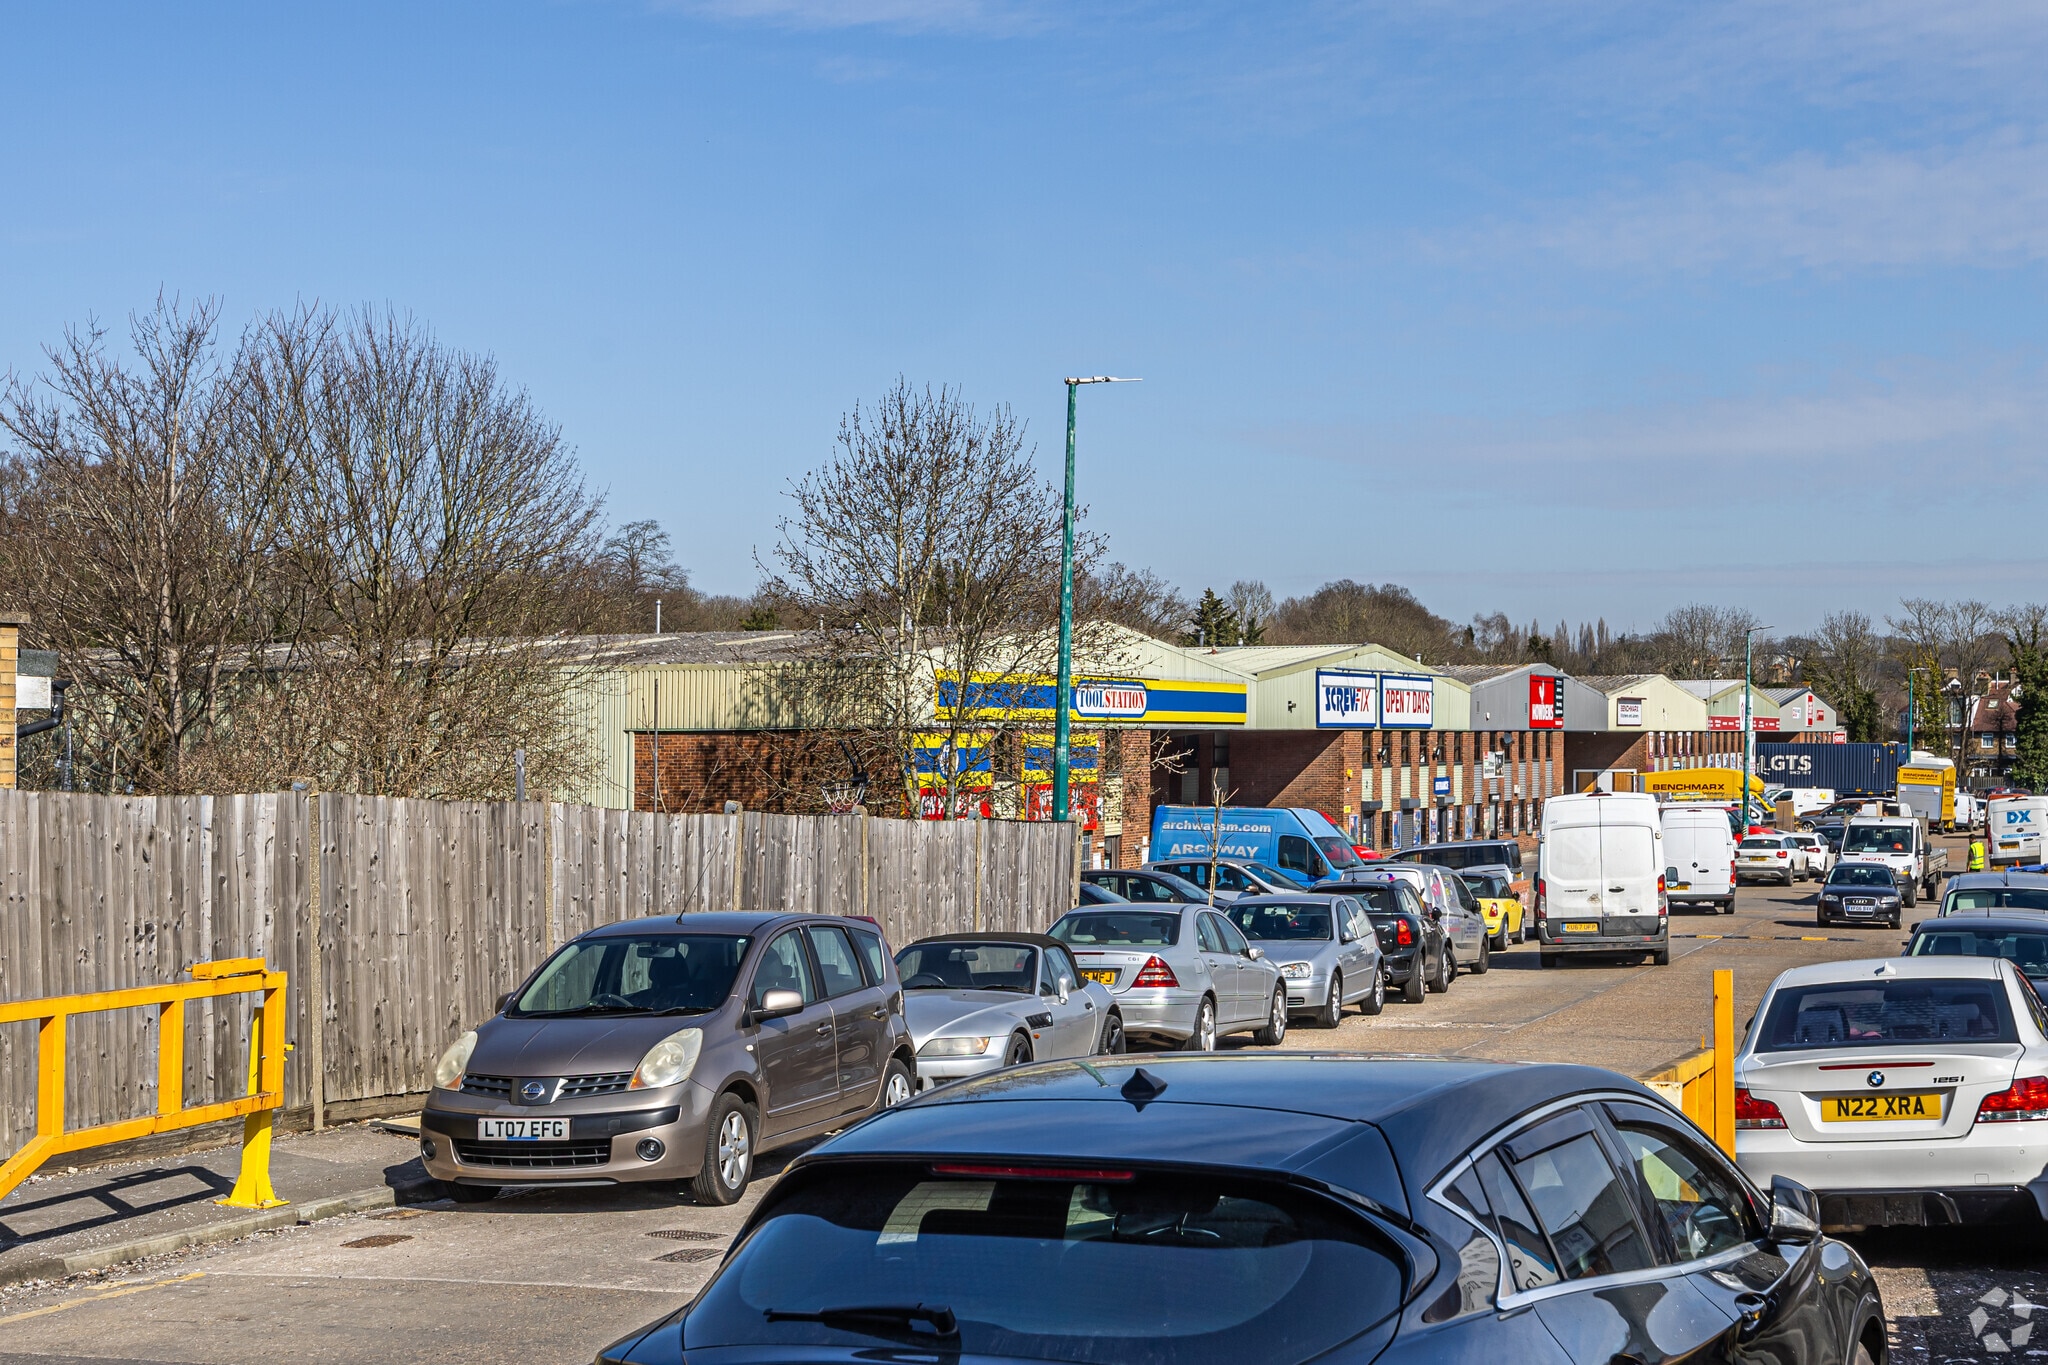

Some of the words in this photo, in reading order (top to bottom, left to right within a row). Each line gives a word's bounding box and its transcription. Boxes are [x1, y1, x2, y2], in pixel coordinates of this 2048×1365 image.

[1079, 690, 1145, 709] TOOLSTATION
[1325, 687, 1371, 717] SCREWFIX
[1385, 689, 1405, 714] OPEN
[1406, 691, 1411, 713] 7
[1412, 691, 1430, 714] DAYS
[1770, 755, 1812, 771] GTS
[1652, 783, 1725, 791] BENCHMARX
[2006, 809, 2032, 824] DX
[1093, 972, 1112, 982] MFJ
[1837, 1098, 1878, 1117] N22
[1884, 1096, 1925, 1115] XRA
[485, 1121, 525, 1137] LT07
[530, 1121, 563, 1137] EFG
